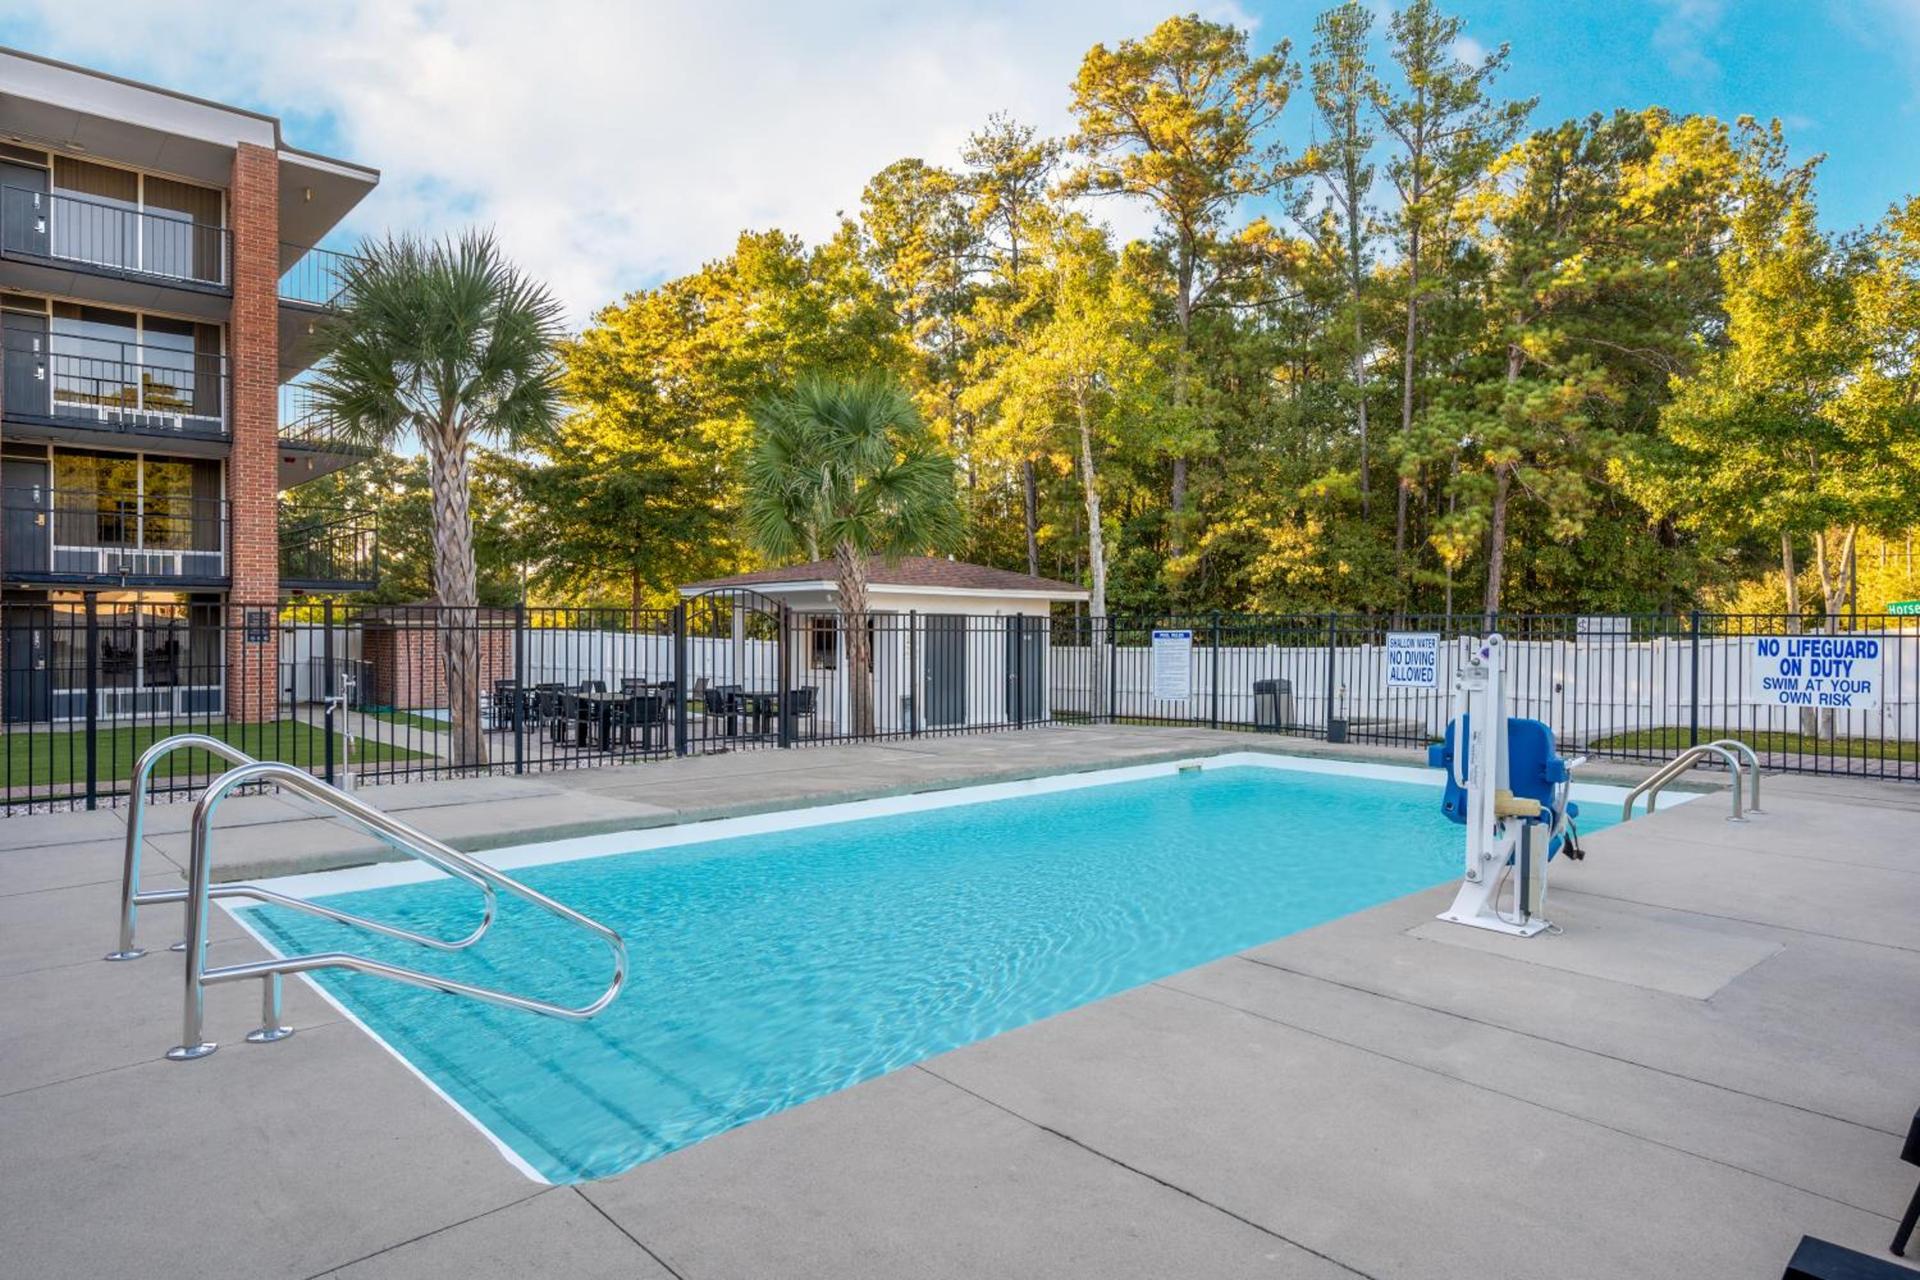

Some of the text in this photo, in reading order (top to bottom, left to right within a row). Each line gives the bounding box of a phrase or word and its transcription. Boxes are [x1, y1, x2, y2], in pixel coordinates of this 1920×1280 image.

[1390, 638, 1435, 648] SHALLOW WATER
[1758, 639, 1879, 659] NO LIFEGUARD
[1390, 651, 1435, 665] NO DIVING
[1391, 667, 1433, 682] ALLOWED
[1780, 658, 1853, 677] ON DUTY
[1763, 677, 1871, 693] SWIM AT YOUR
[1779, 691, 1852, 706] OWN RISK
